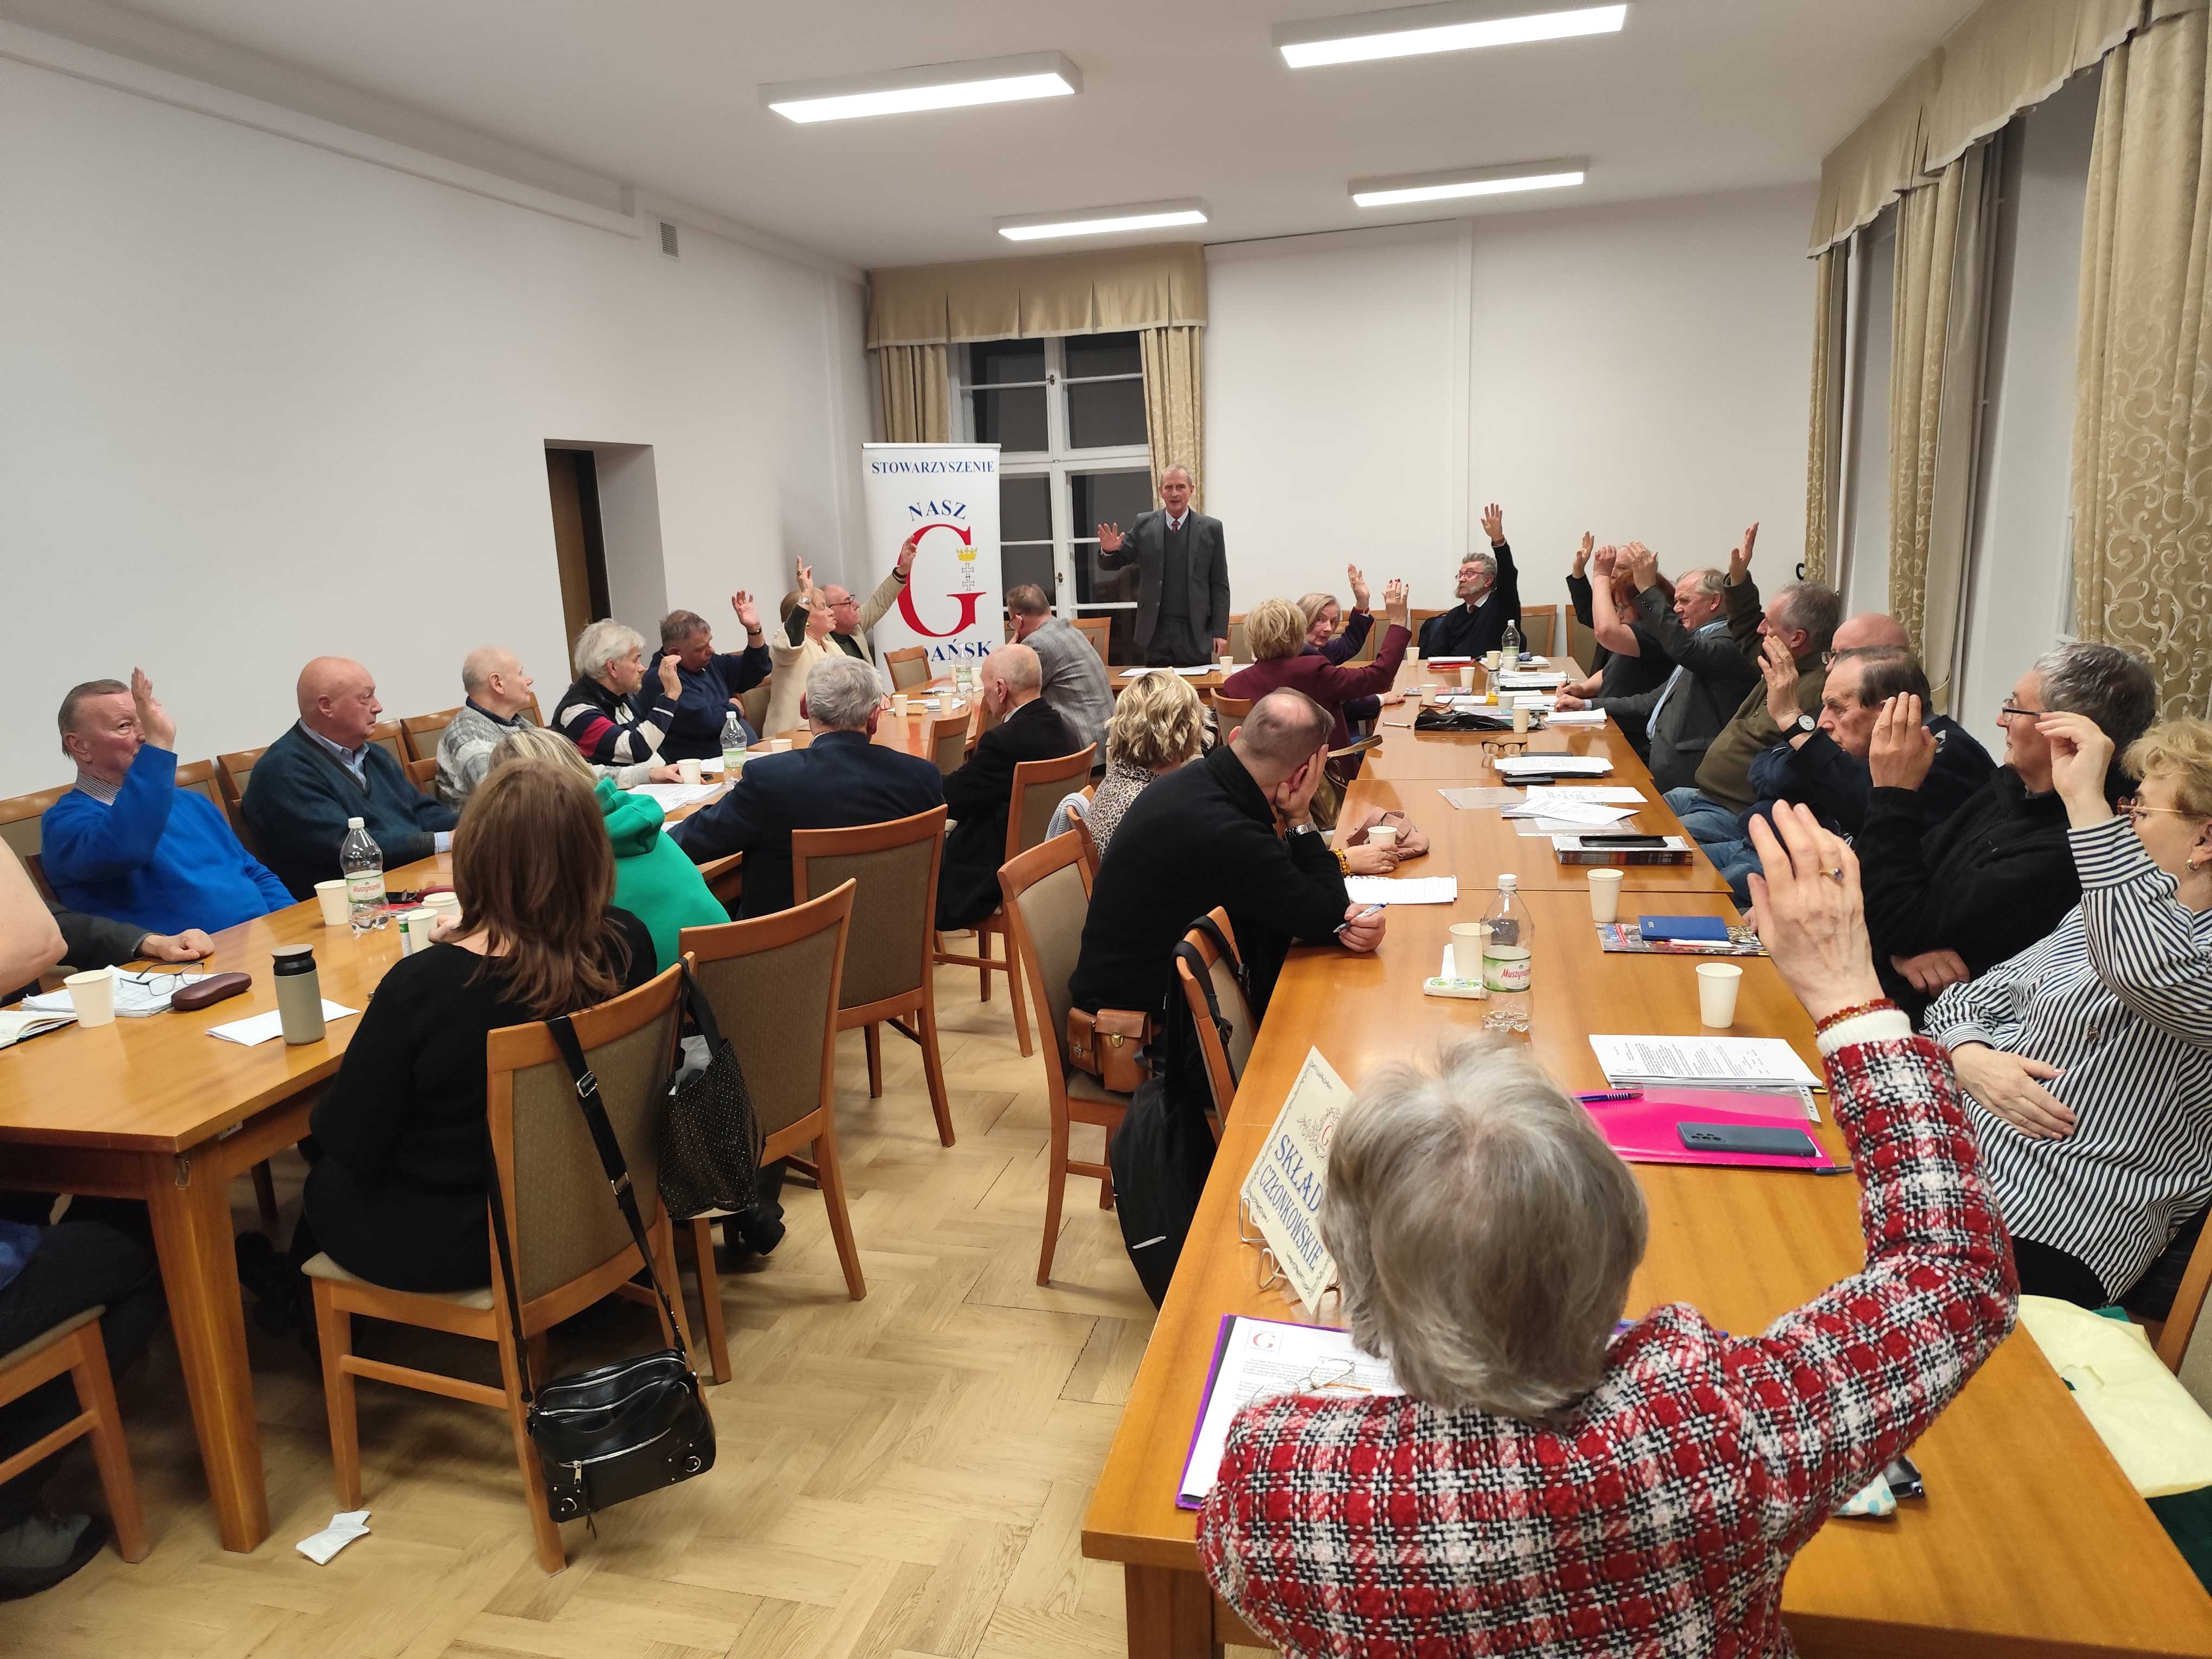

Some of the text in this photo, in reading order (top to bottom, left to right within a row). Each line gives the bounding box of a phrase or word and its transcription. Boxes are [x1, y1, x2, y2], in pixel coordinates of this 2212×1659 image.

[872, 461, 995, 474] STOWARZYSZENIE
[908, 499, 967, 522] NASZ
[897, 524, 987, 638] G
[899, 639, 992, 662] AŃSK
[1274, 1134, 1323, 1214] SKŁAD
[1259, 1164, 1323, 1273] CZŁONKOWSKIE
